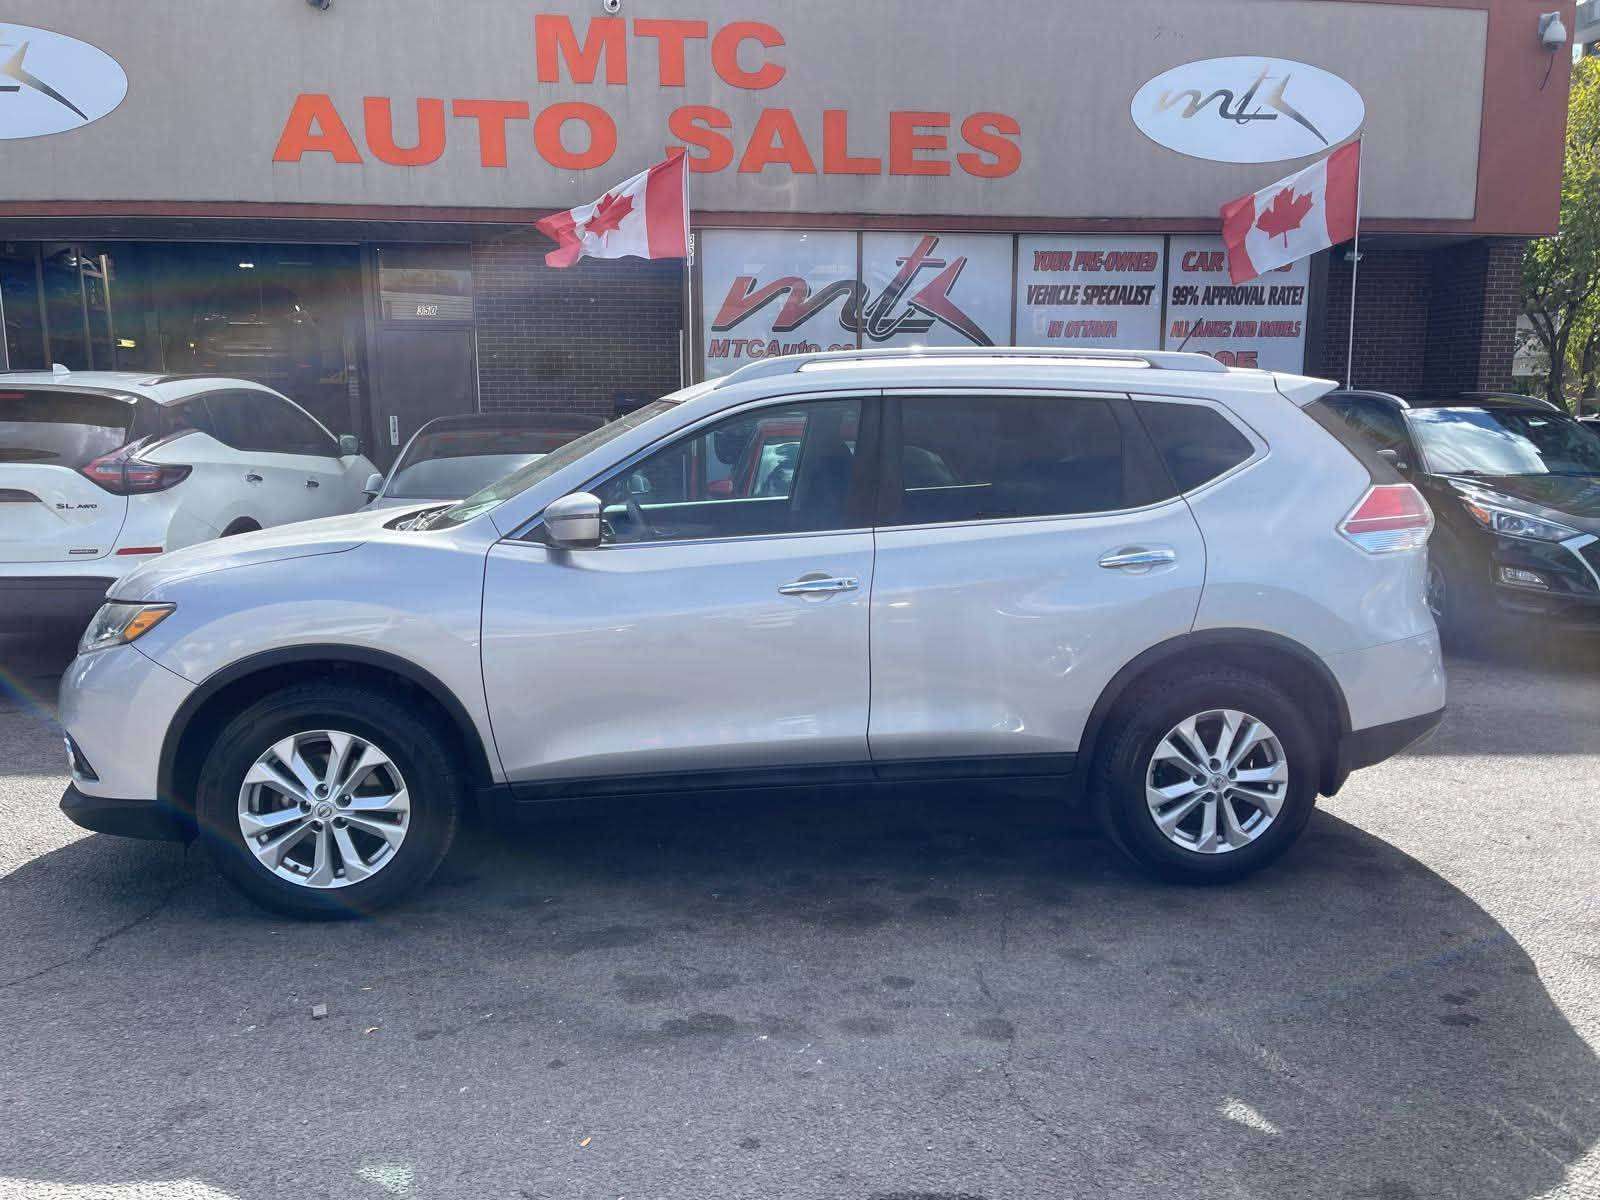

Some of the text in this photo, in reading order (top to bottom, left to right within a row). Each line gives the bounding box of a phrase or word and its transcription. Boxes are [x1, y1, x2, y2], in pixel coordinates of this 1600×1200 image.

[535, 14, 786, 90] MTC
[272, 94, 1022, 178] AUTO SALES
[1033, 250, 1159, 272] YOUR PRE-OWNED
[1181, 251, 1225, 272] CAR
[1027, 284, 1156, 305] VEHICLE SPECIALIST
[1172, 285, 1305, 306] 99% APPROVAL RATE!
[1048, 320, 1118, 338] IN OTTAWA
[1232, 320, 1258, 337] AND
